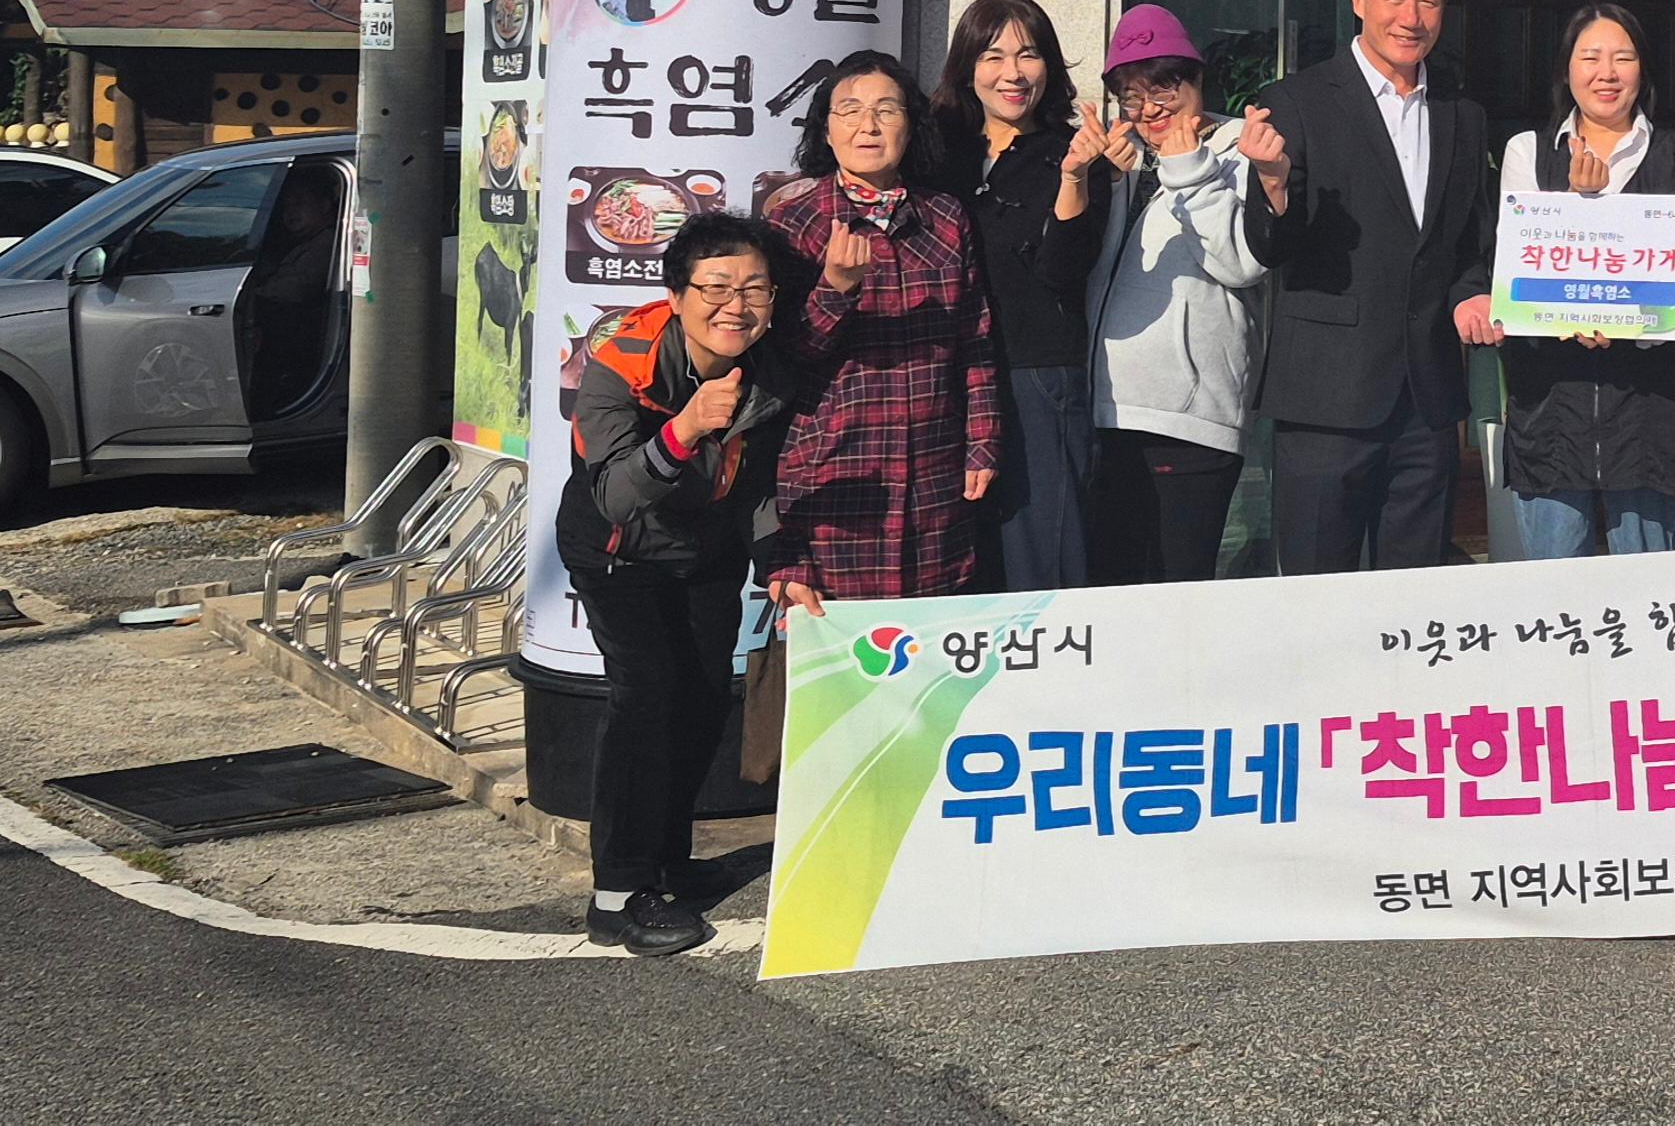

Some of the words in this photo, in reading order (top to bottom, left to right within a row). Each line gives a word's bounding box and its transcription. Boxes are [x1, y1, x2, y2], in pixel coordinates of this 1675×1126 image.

[1563, 282, 1632, 301] 영월흑염소
[943, 625, 1092, 673] 양산시
[1380, 623, 1498, 667] 이웃과
[1515, 612, 1633, 659] 나눔을
[941, 722, 1300, 844] 우리동네
[1372, 870, 1454, 914] 동면
